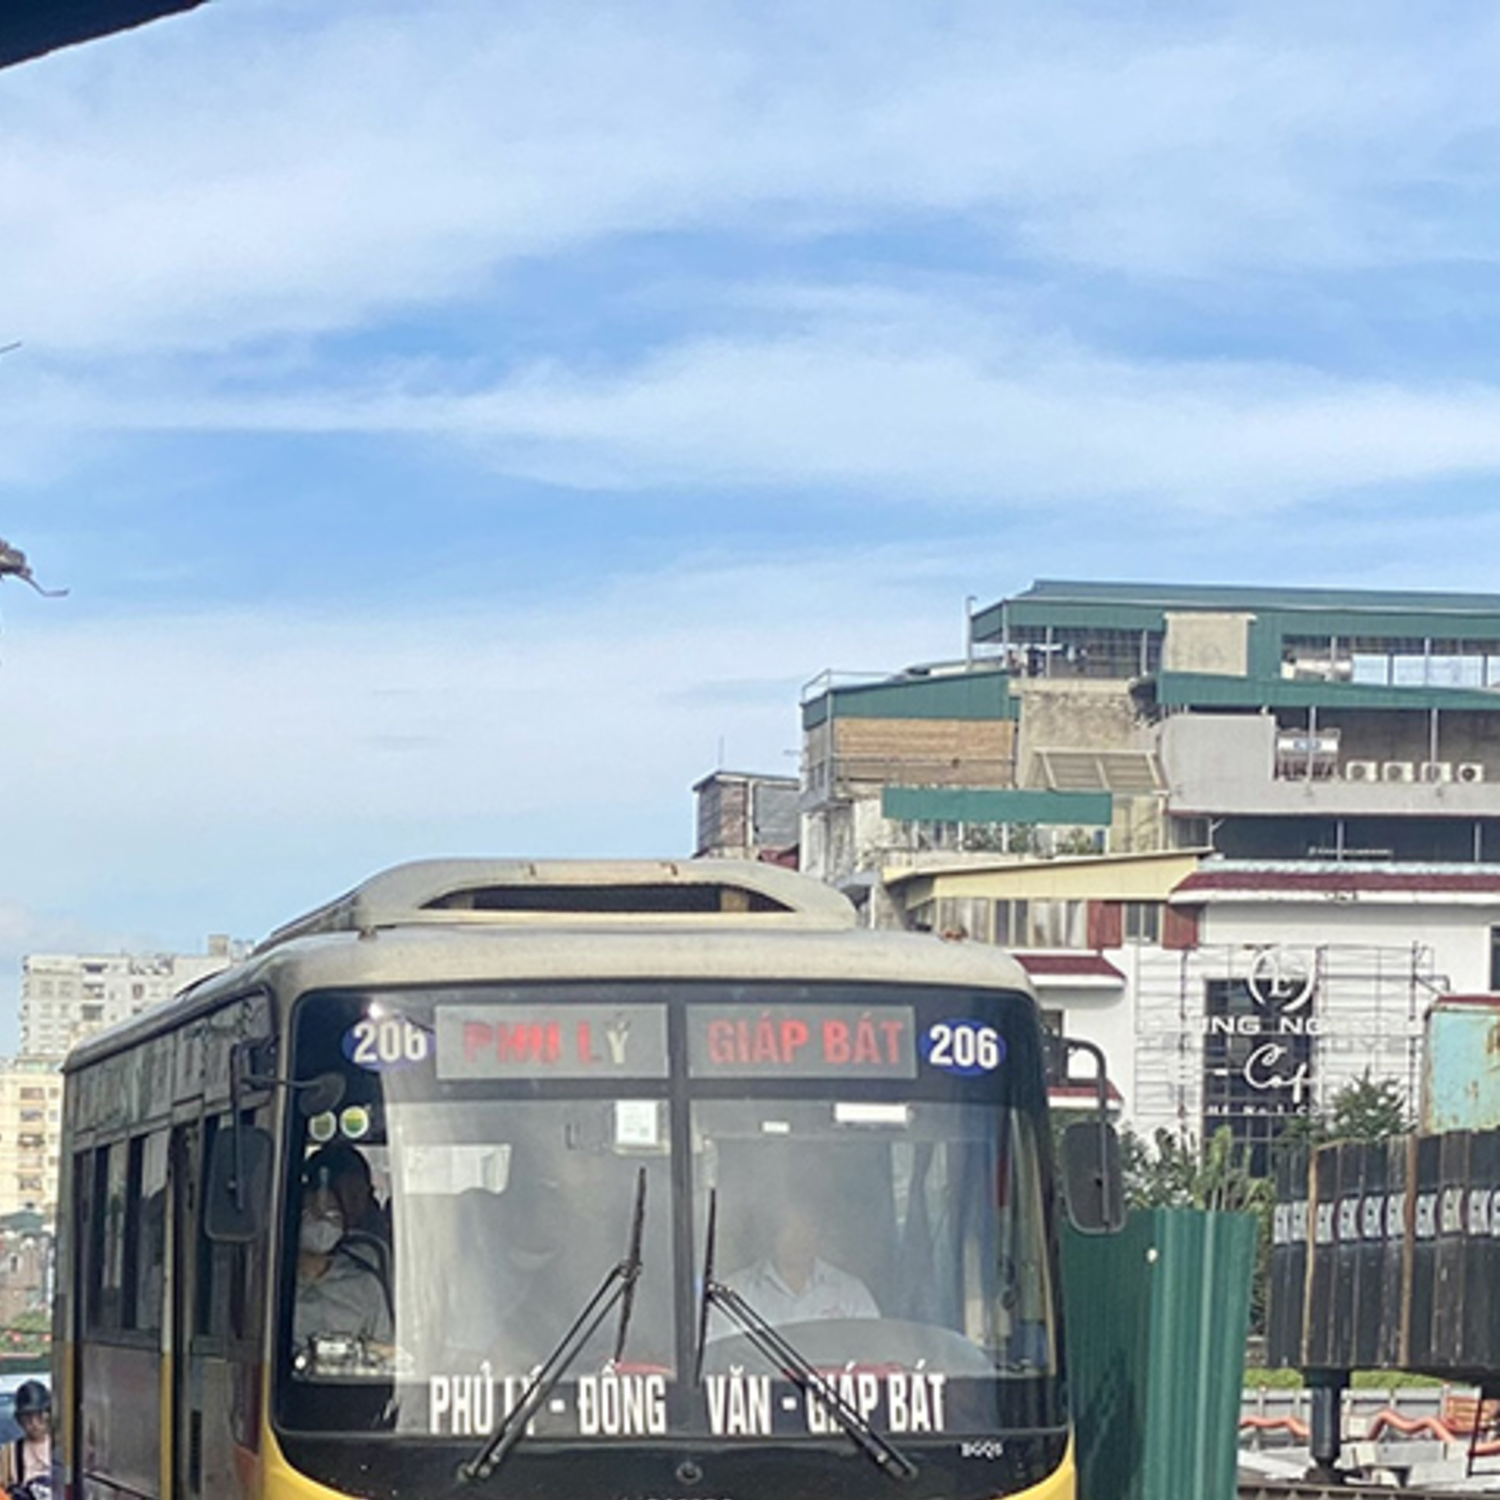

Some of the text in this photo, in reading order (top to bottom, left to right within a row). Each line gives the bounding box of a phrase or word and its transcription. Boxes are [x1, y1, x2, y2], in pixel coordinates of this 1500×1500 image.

[707, 1009, 904, 1065] GIÁP BÁT
[928, 1023, 999, 1070] 206
[429, 1359, 494, 1436] PHỦ
[706, 1364, 772, 1435] VĂN
[886, 1358, 947, 1433] BÁT
